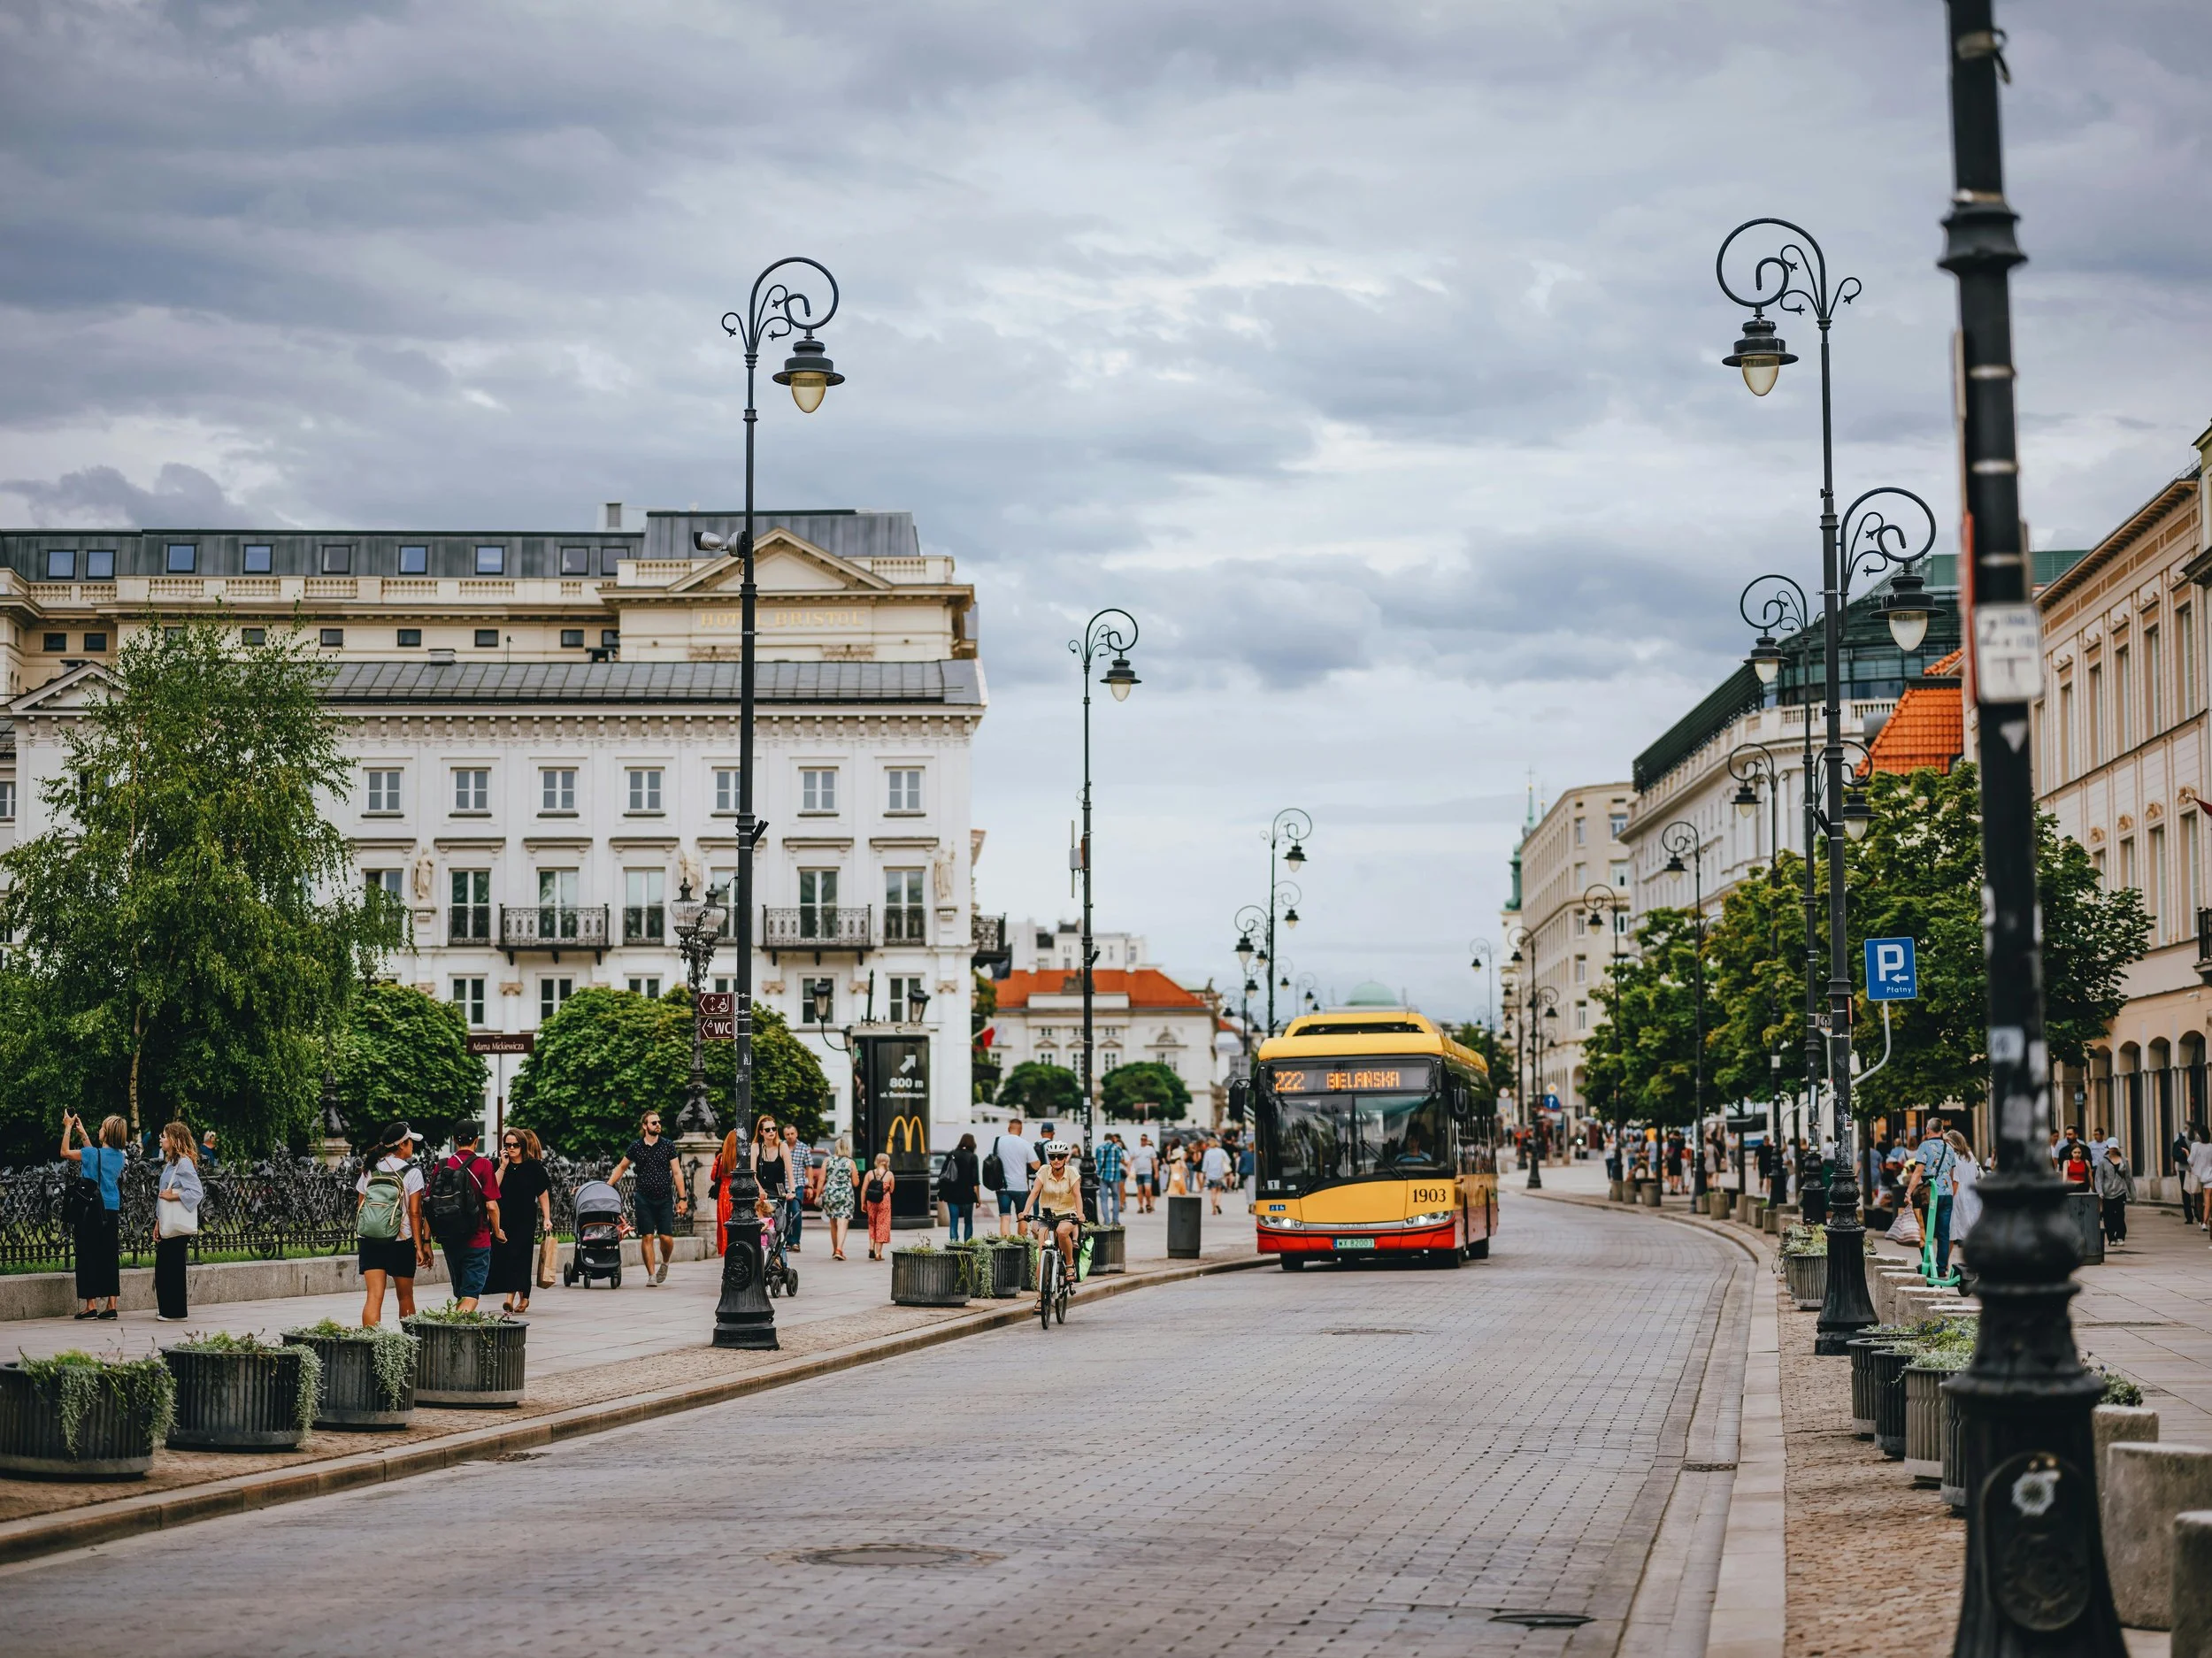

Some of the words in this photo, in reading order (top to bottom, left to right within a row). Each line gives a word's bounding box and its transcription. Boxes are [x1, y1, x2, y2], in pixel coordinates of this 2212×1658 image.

[701, 611, 766, 627] HOTL
[775, 610, 865, 627] BRISTOL
[1877, 945, 1904, 981] P
[714, 1022, 732, 1034] WC
[492, 1041, 524, 1050] Mickiewicza
[889, 1078, 912, 1087] 800
[915, 1079, 924, 1088] m
[1275, 1071, 1305, 1091] 222
[1413, 1188, 1446, 1202] 1903
